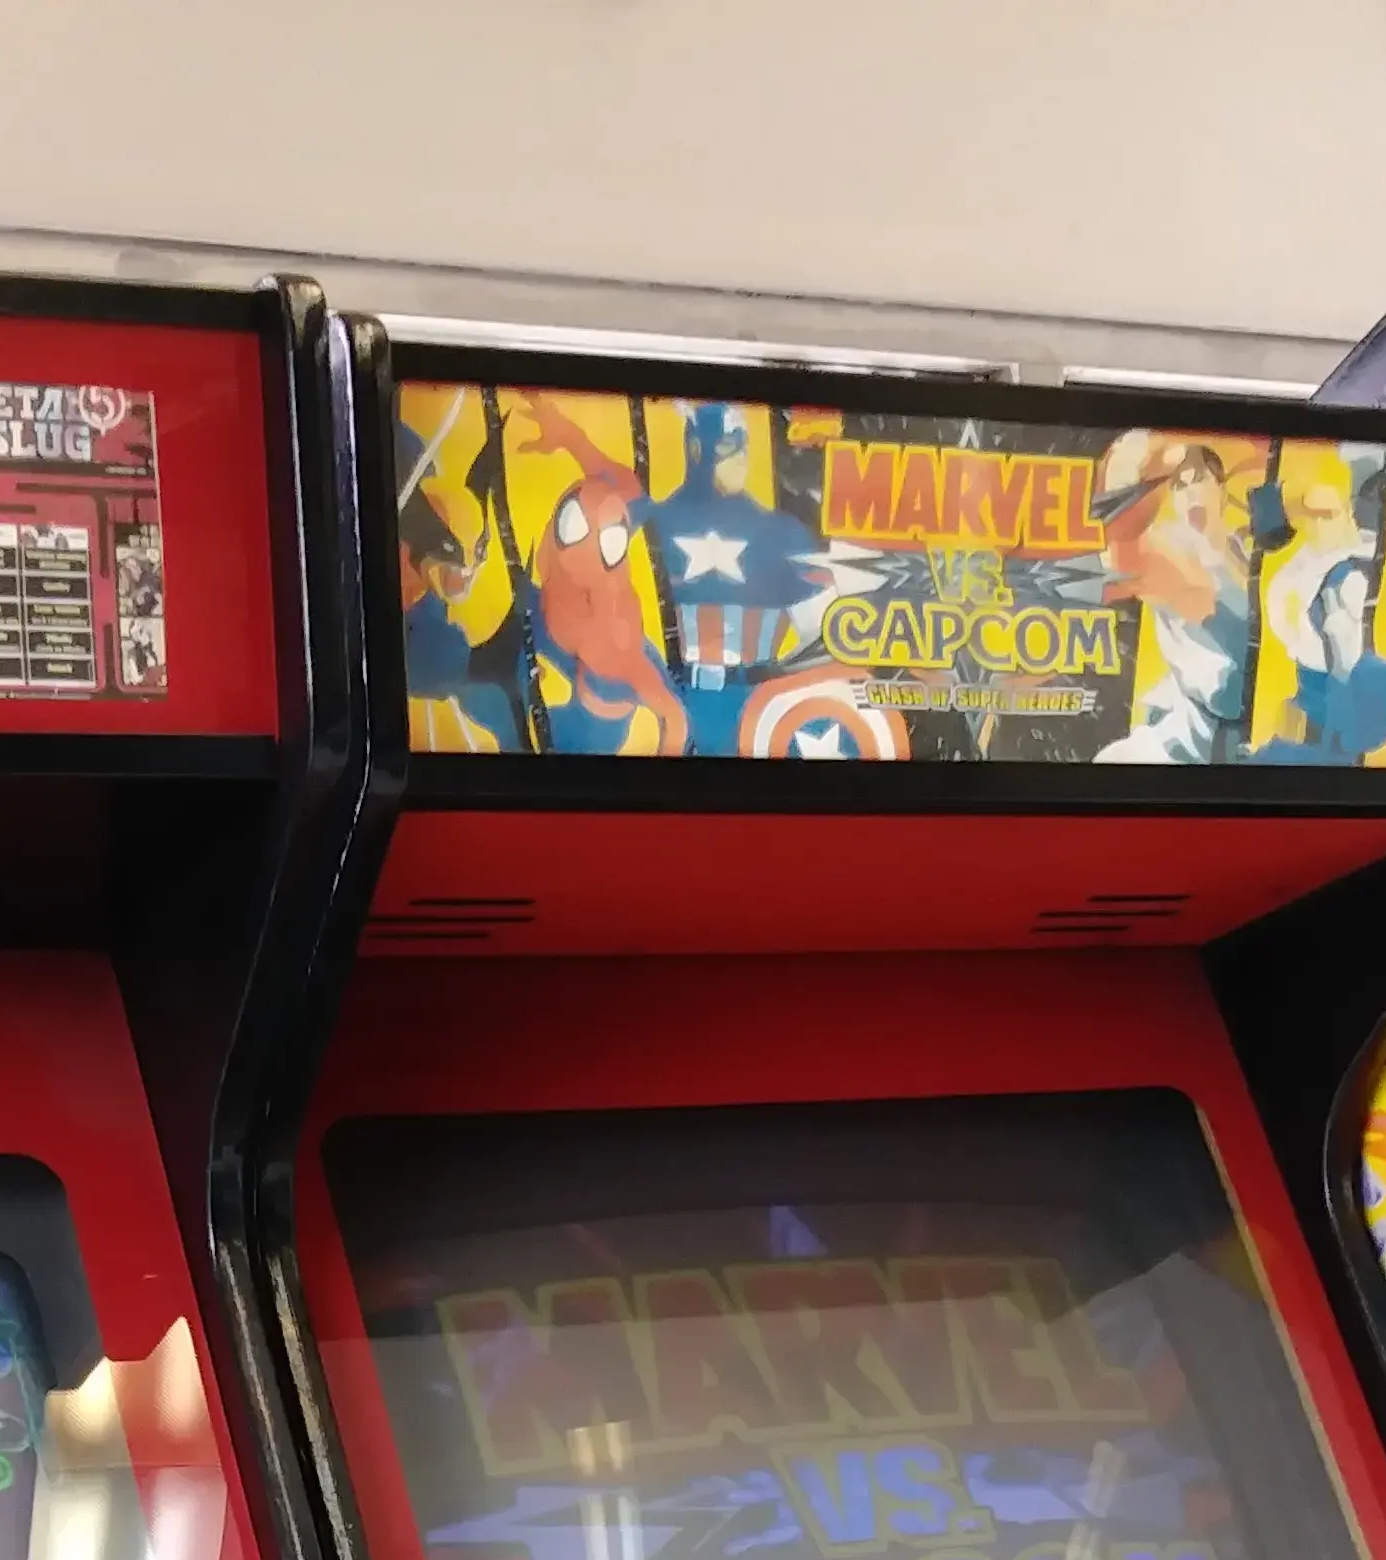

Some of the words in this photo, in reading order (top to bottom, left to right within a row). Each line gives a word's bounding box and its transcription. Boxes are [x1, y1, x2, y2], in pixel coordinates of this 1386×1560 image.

[821, 440, 1105, 550] MARVEL
[823, 598, 1121, 675] CAPCOM
[436, 1257, 1148, 1475] MARVEL
